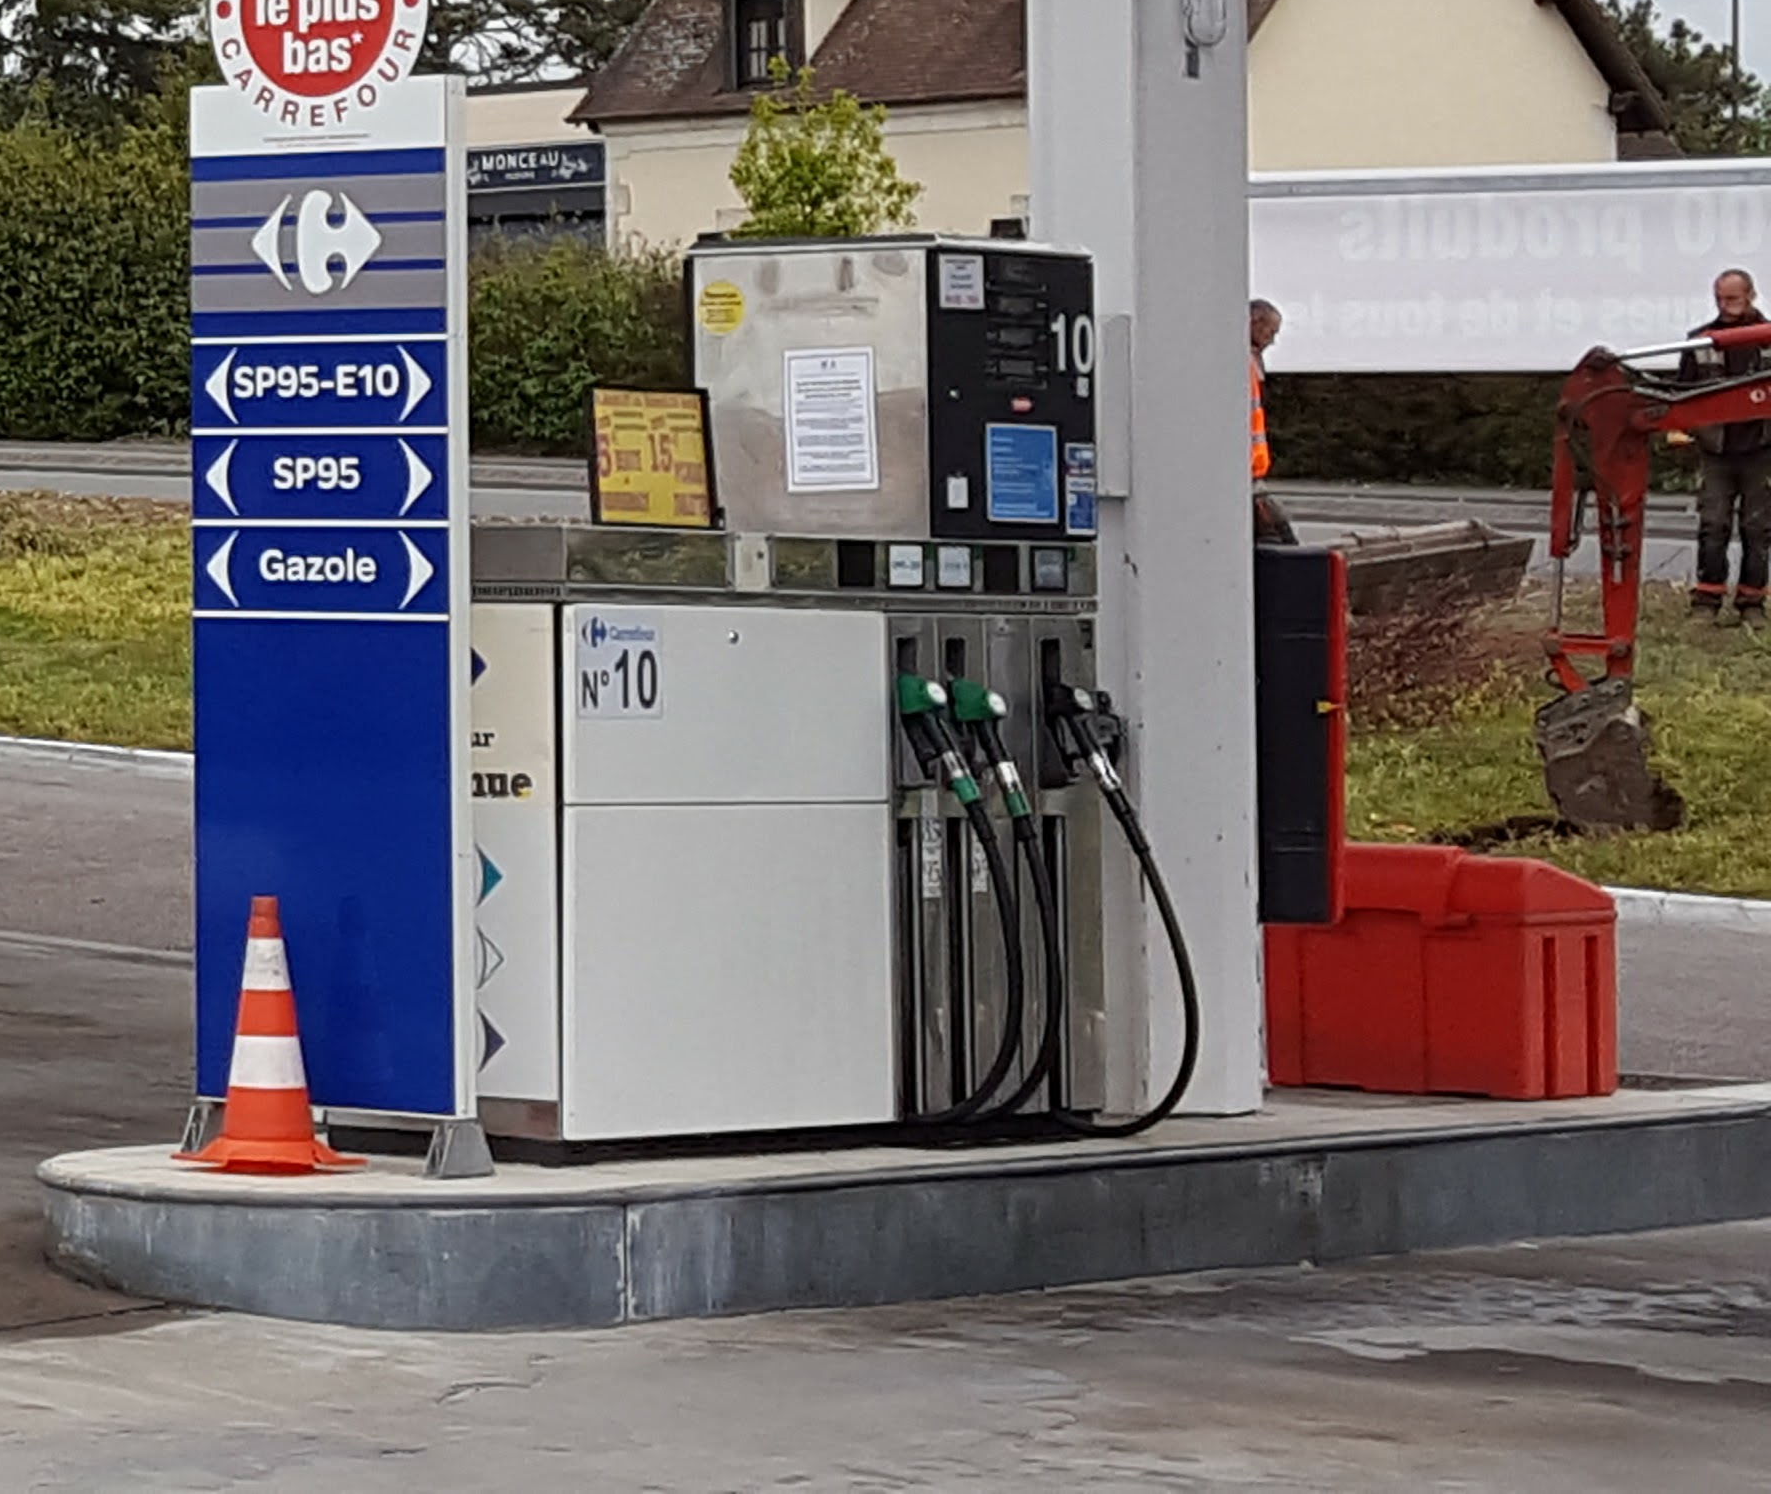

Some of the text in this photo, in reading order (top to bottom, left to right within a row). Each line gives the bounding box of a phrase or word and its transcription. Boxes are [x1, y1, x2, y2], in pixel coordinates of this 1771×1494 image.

[222, 28, 416, 127] CARREFOUR
[481, 150, 559, 171] MONCEAU
[1050, 312, 1095, 374] 10
[233, 361, 401, 400] SP95-E10
[272, 456, 361, 490] SP95
[259, 547, 378, 584] Gazole
